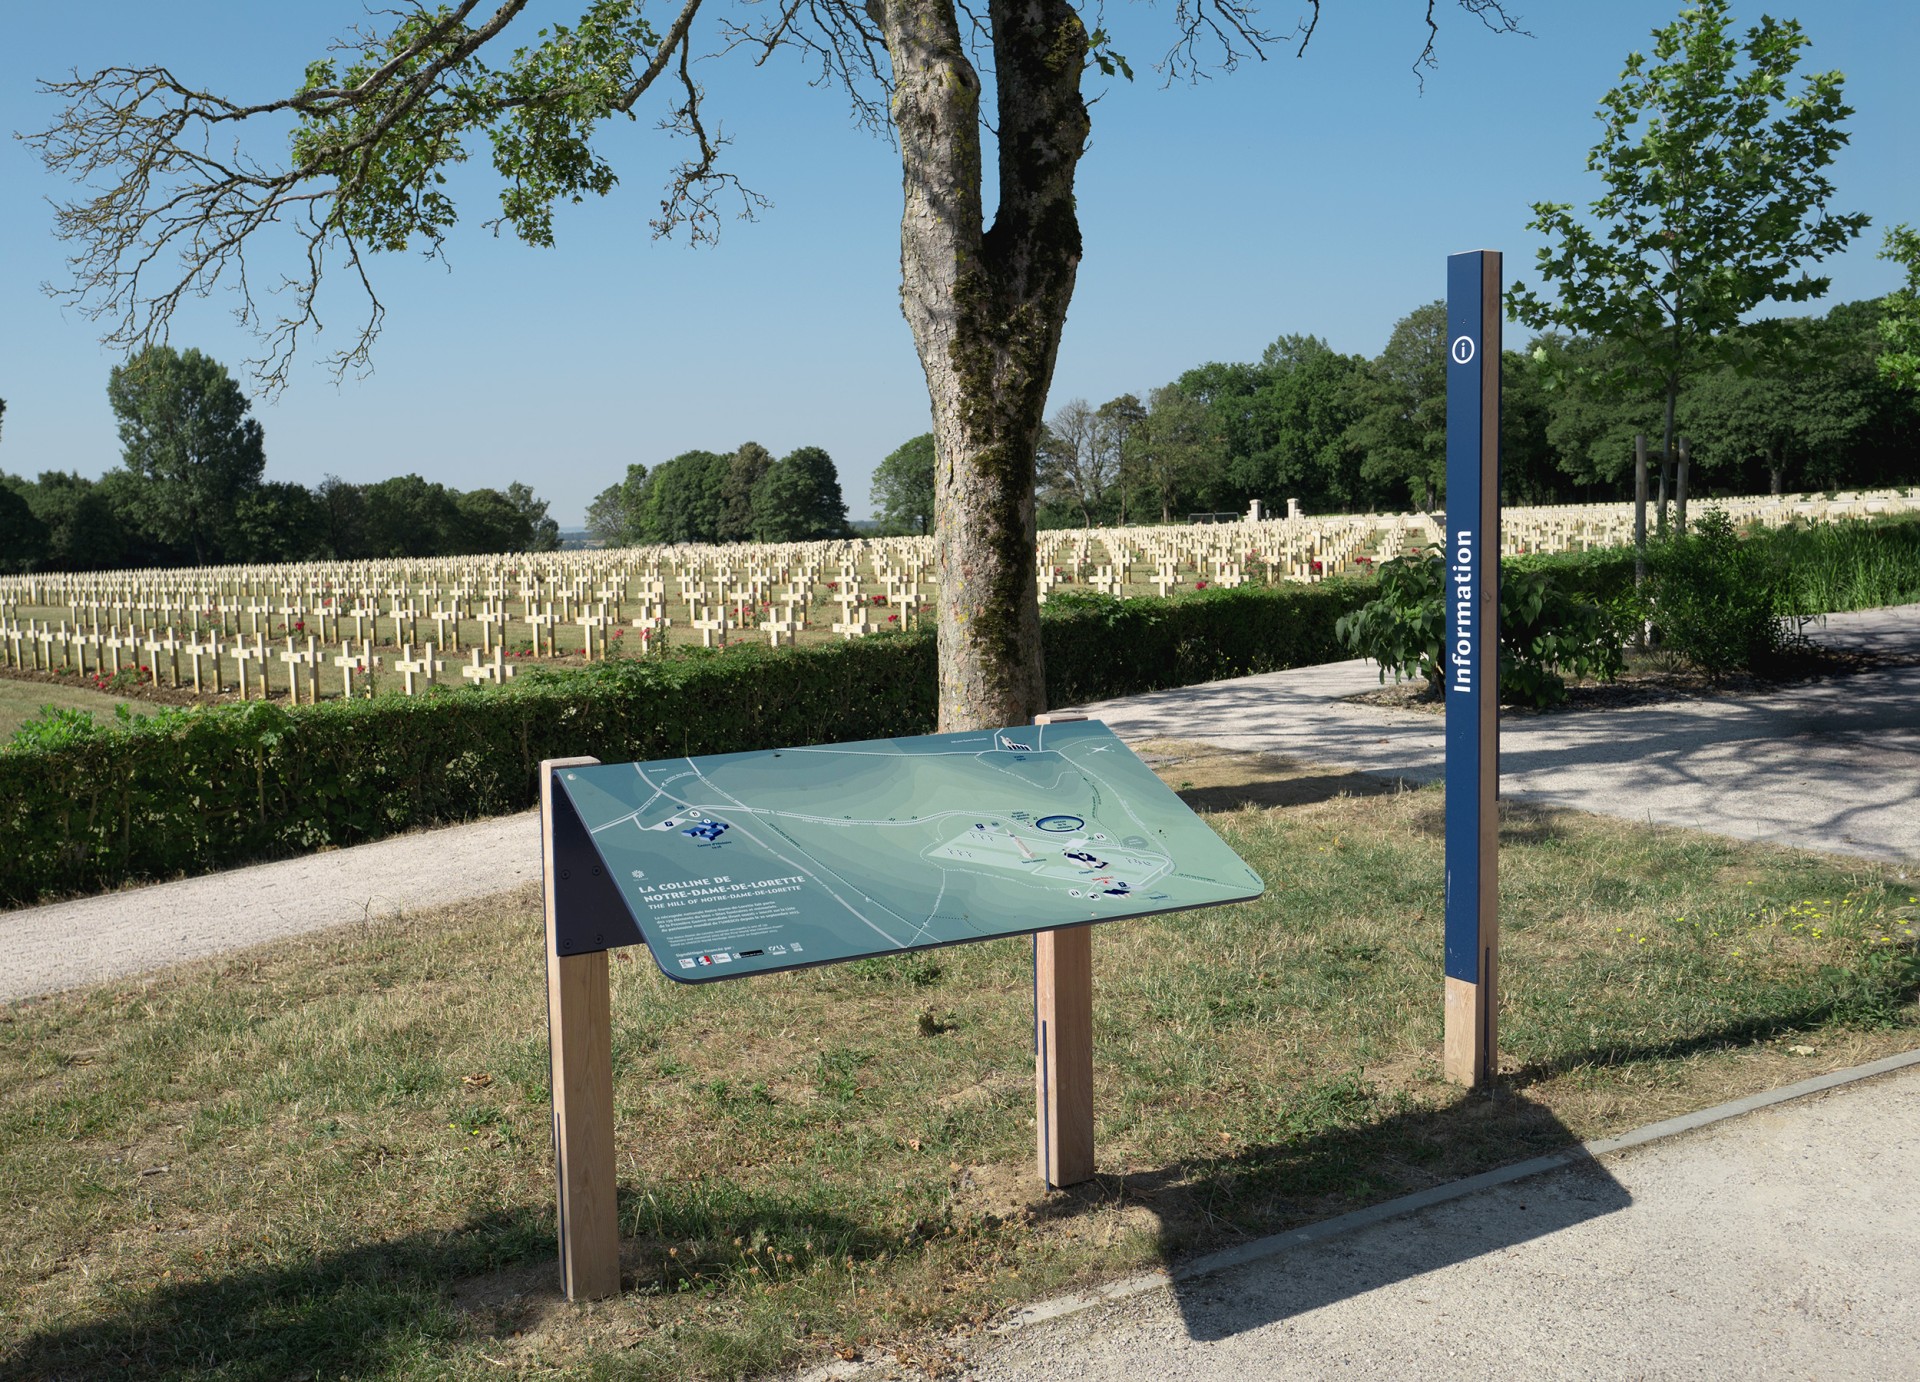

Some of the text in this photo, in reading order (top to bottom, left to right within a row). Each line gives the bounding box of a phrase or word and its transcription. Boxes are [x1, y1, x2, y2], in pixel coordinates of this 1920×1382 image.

[1452, 529, 1472, 693] Information
[643, 876, 805, 902] NOTRE-DAME-DE-LORETTE
[659, 878, 711, 890] COLLINE
[701, 885, 802, 903] NOTRE-DAME-DE-LORETTE
